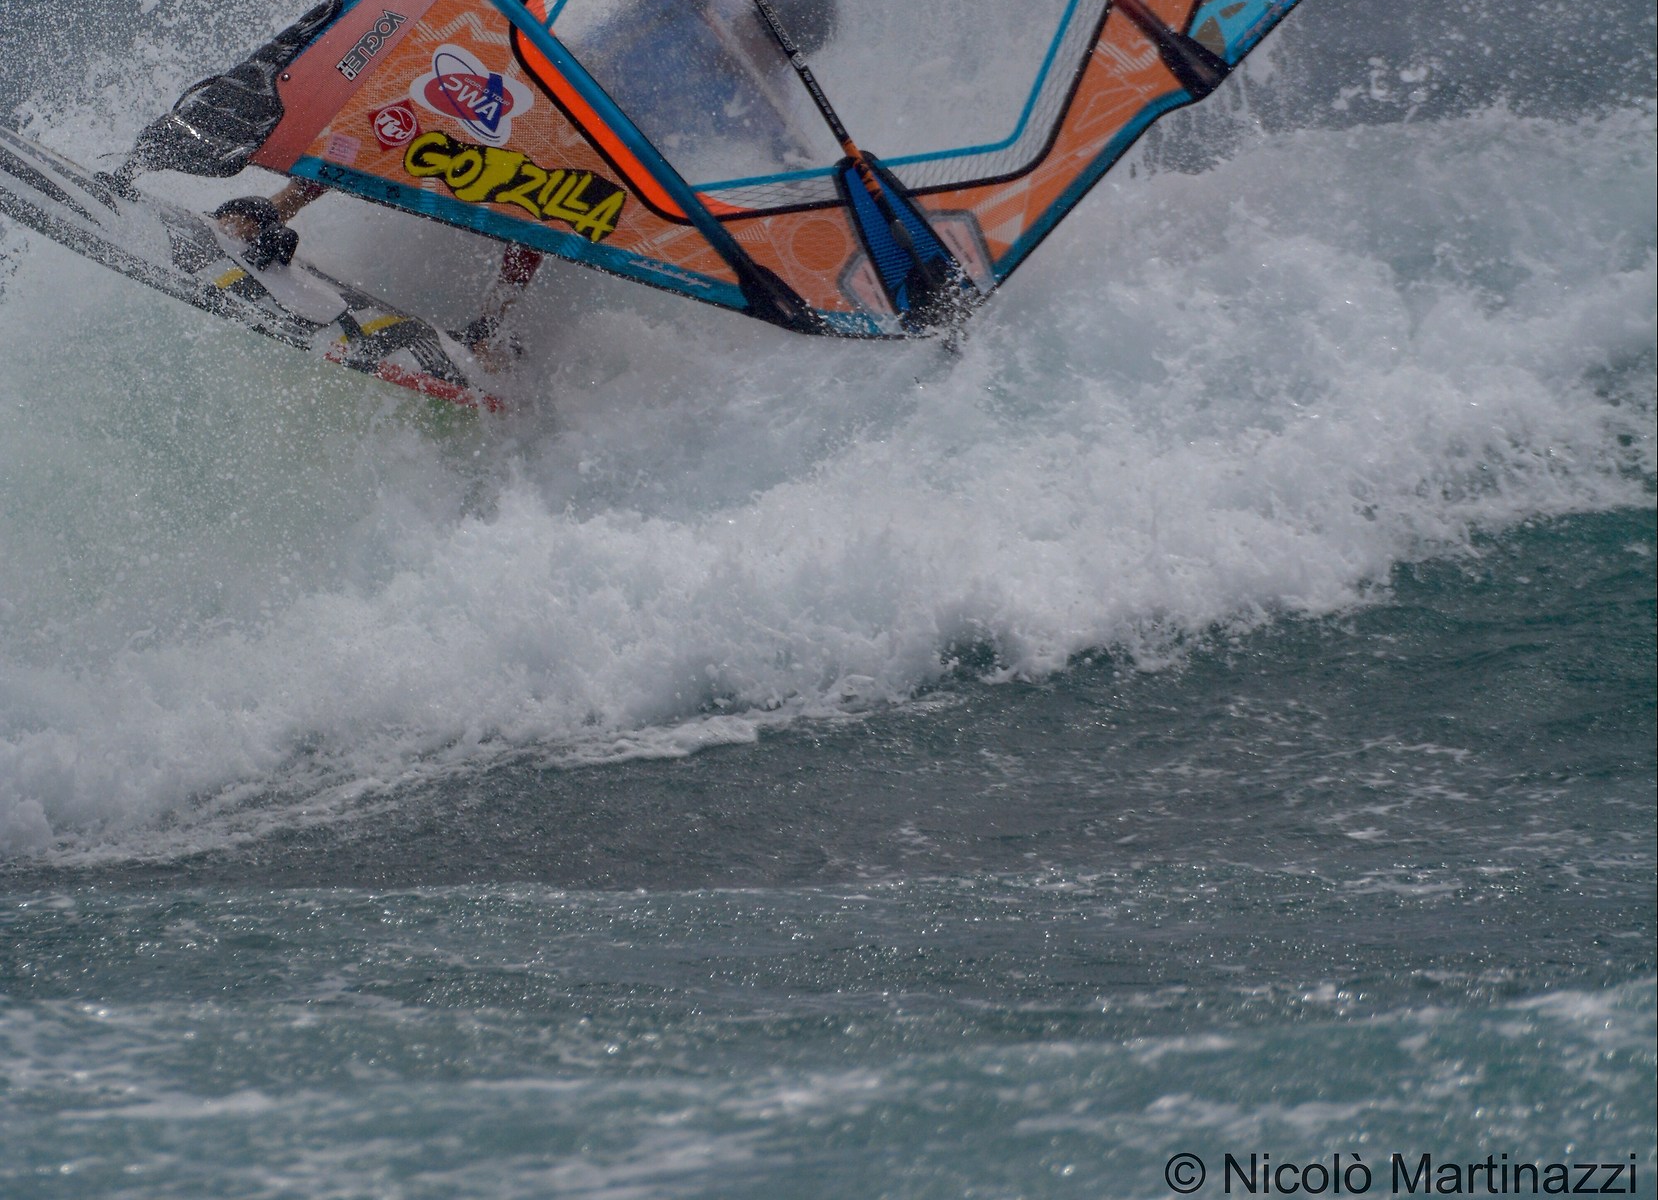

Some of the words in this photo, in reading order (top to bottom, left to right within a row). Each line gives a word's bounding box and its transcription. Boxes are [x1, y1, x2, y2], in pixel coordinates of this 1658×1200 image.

[438, 76, 499, 121] PWA
[464, 77, 489, 94] WORLD
[491, 93, 510, 106] TOUR
